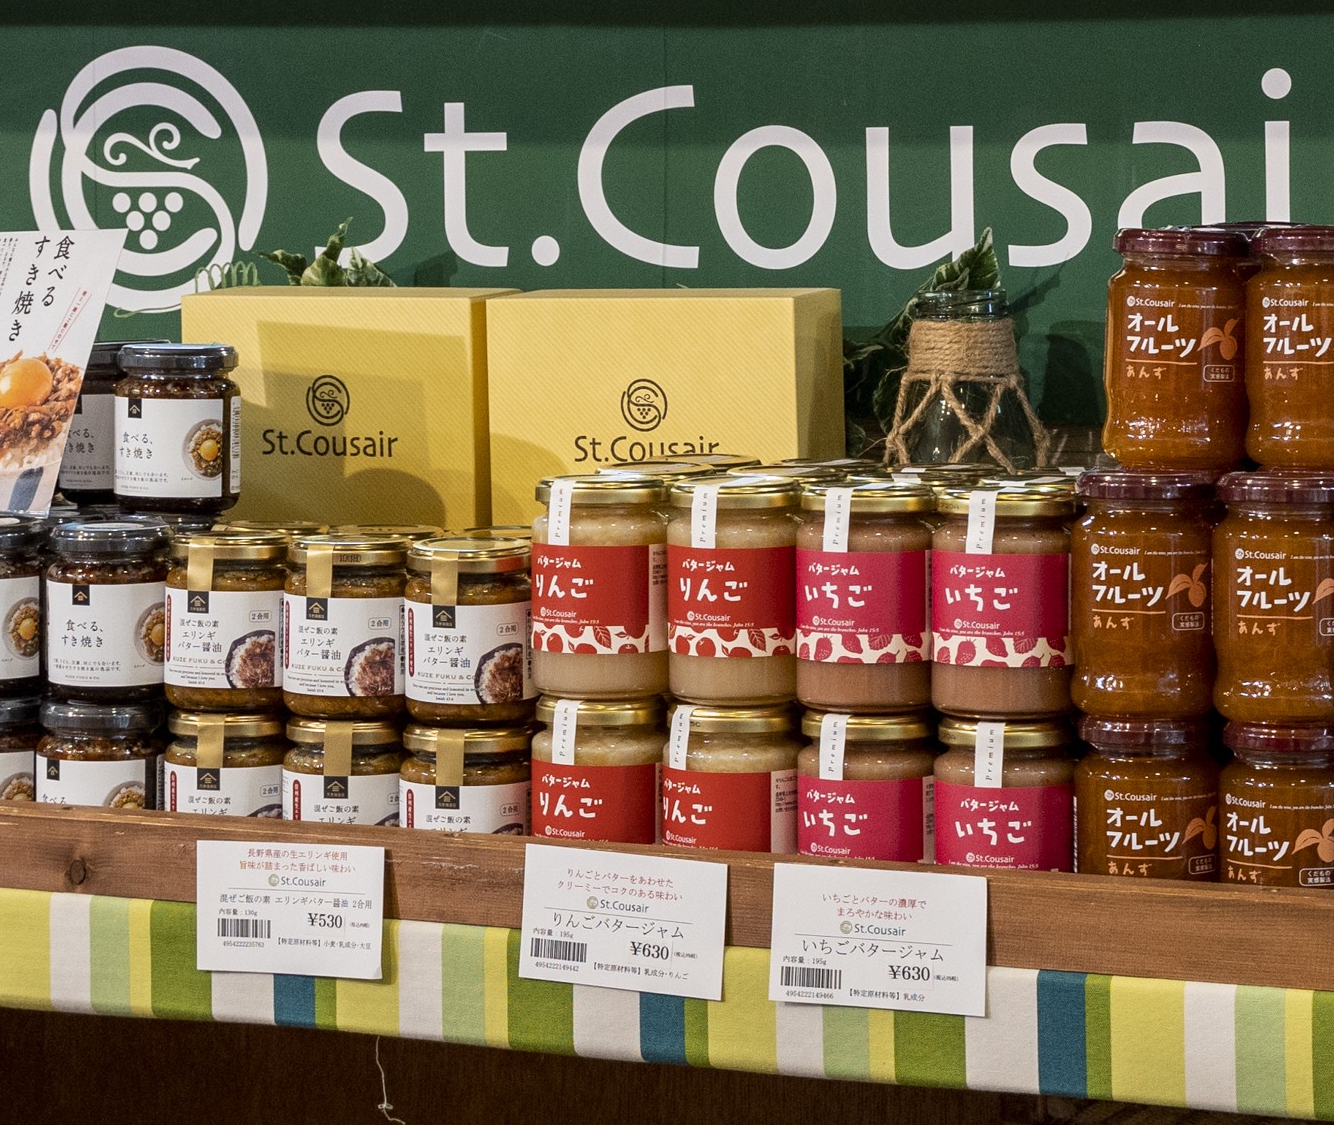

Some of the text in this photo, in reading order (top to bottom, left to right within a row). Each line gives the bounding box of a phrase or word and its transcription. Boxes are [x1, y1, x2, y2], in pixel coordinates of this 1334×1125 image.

[1136, 298, 1175, 308] St.Cousair
[1127, 312, 1179, 332] オール
[1126, 335, 1196, 358] フルーツ
[1126, 364, 1167, 380] あんず
[261, 428, 399, 459] St.Cousair
[574, 436, 719, 462] St.Cousair
[1244, 550, 1286, 560] St.Cousair
[682, 559, 735, 572] バタージャム
[950, 565, 1005, 578] バタージャム
[1237, 566, 1292, 586] オール
[679, 577, 748, 602] りんご
[945, 583, 1018, 611] いちご
[1237, 590, 1311, 613] フルーツ
[696, 614, 731, 622] St.Cousair
[963, 621, 1000, 629] St.Cousair
[1238, 621, 1281, 636] あんず
[61, 634, 104, 648] すき焼き
[427, 645, 464, 655] エリンギ
[423, 657, 471, 668] バター醤油
[248, 848, 348, 861] 長野県産の生エリンギ使用
[239, 861, 356, 874] 旨味が詰まった香ばしい味わい
[281, 876, 327, 887] St.Cousair
[567, 868, 674, 888] りんごとバターをあわせた
[557, 881, 683, 901] クリーミーでコクのある味わい
[220, 894, 373, 910] 混ぜご飯の素 エリンギバター醤油 2合用
[600, 899, 650, 914] St.Cousair
[822, 893, 927, 909] いちごとバターの濃厚で
[308, 912, 342, 929] ¥530
[837, 907, 913, 921] まろやかな味わい
[553, 912, 685, 940] りんごバタージャム
[854, 923, 906, 936] St.Cousair
[629, 941, 669, 960] ¥630
[802, 939, 944, 962] いちごバタージャム
[888, 964, 931, 981] ¥630
